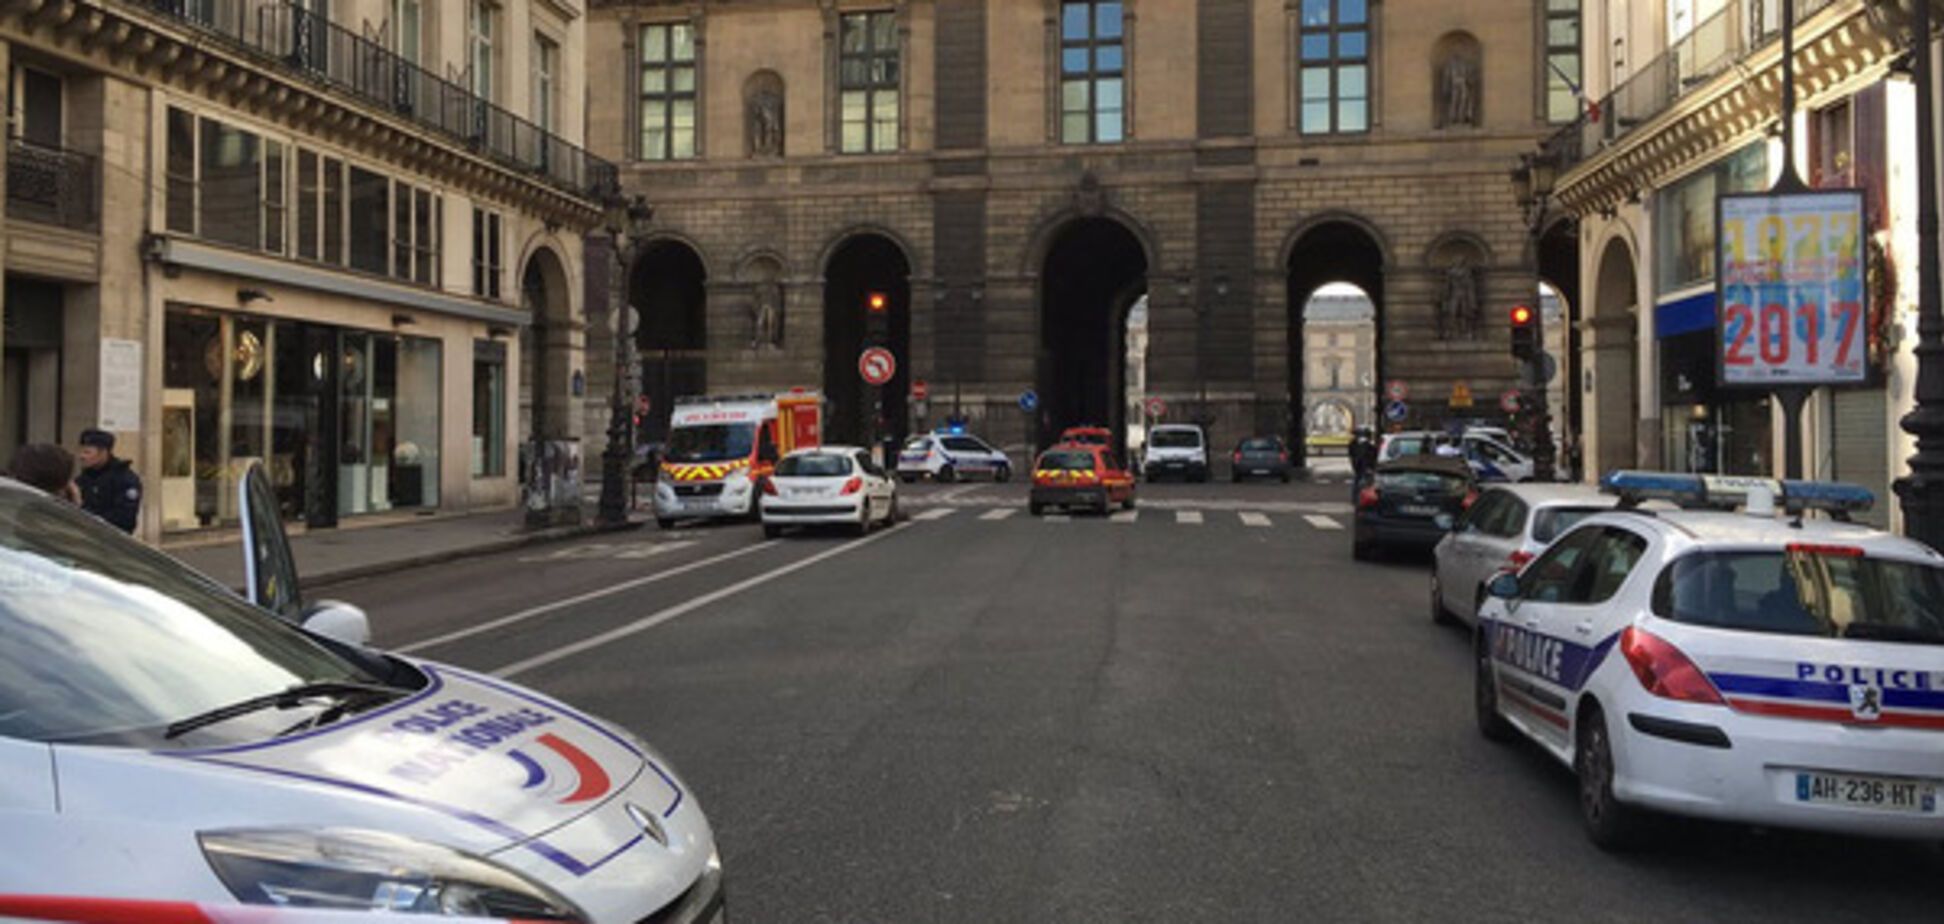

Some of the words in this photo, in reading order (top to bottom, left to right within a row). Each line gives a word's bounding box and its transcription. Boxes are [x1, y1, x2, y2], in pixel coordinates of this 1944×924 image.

[1725, 302, 1861, 366] 2017
[1506, 628, 1564, 681] POLICE
[1796, 662, 1931, 690] POLICE
[1811, 776, 1917, 806] AH-236-HT
